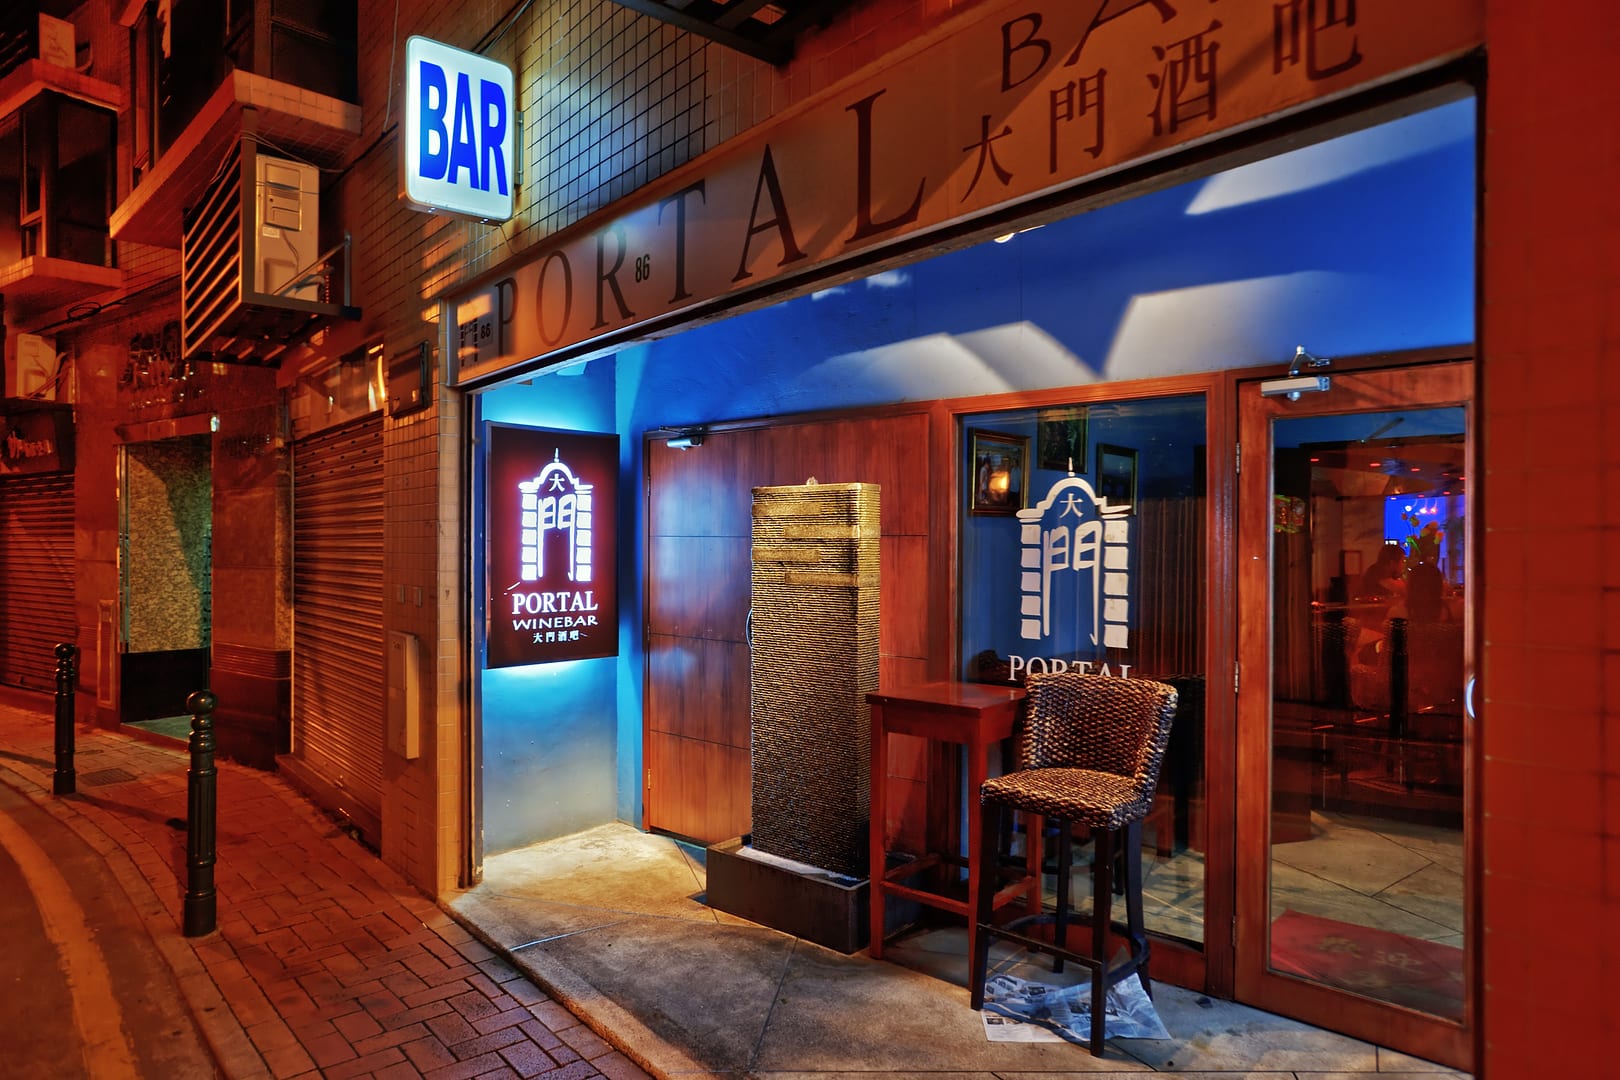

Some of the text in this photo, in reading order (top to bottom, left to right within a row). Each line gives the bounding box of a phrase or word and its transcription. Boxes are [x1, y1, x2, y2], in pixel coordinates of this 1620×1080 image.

[419, 60, 509, 197] BAR
[960, 0, 1364, 203] 大門酒吧
[494, 88, 926, 358] PORTAL
[635, 254, 650, 283] 86
[511, 590, 599, 615] PORTAL
[512, 615, 599, 631] WINEBAR
